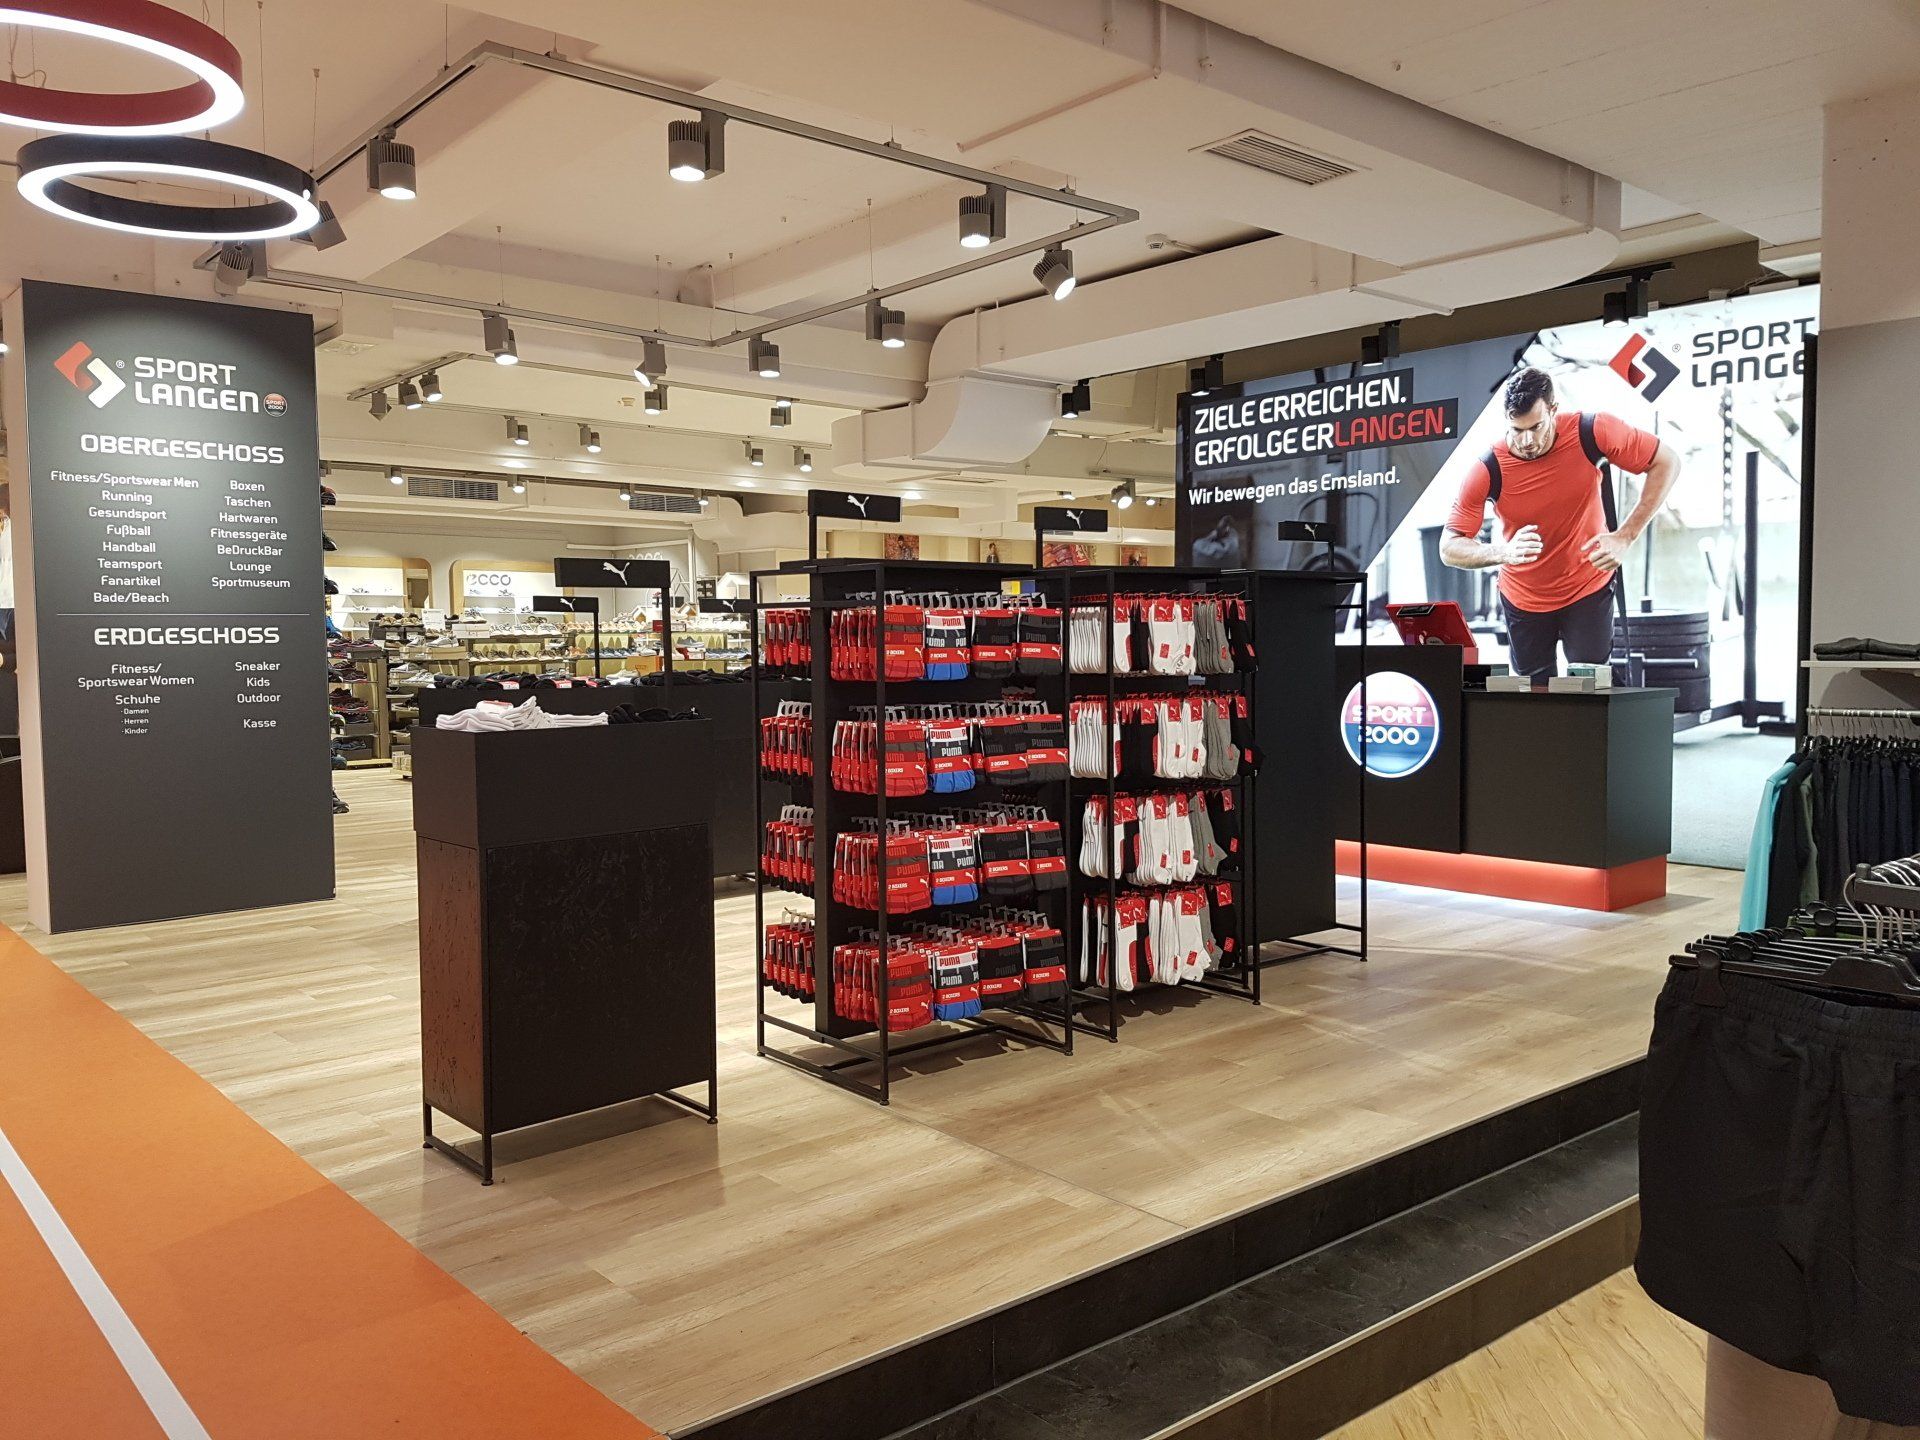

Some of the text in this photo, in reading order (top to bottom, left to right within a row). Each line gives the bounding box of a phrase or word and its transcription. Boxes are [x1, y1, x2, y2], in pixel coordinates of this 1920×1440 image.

[1692, 317, 1815, 358] SPORT
[134, 356, 237, 385] SPORT
[134, 381, 259, 413] LANGEN
[266, 399, 285, 407] SPORT
[1194, 376, 1407, 435] ZIELE ERREICHEN.
[1194, 406, 1451, 466] ERFOLGE ERLANGEN.
[80, 434, 285, 464] OBERGESCHOSS
[51, 470, 200, 489] Fitness/Sportswear Men
[230, 480, 265, 492] Boxen
[1189, 466, 1401, 506] Wir bewegen das Emsland.
[102, 491, 153, 505] Running
[224, 496, 272, 508] Taschen
[88, 507, 168, 522] Gesundsport
[219, 512, 278, 524] Hartwaren
[106, 525, 151, 538] Fußball
[210, 528, 288, 542] Fitnessgeräte
[102, 541, 156, 553] Handball
[217, 544, 283, 556] BeDruckBar
[97, 558, 163, 571] Teamsport
[229, 561, 272, 574] Lounge
[101, 575, 161, 587] Fanartikel
[211, 577, 291, 590] Sportmuseum
[466, 573, 511, 586] ecco
[93, 592, 170, 604] Bade/Beach
[943, 617, 962, 627] PUMA
[94, 627, 280, 646] ERDGESCHOSS
[927, 637, 945, 648] UMA
[111, 663, 162, 674] Fitness/
[234, 661, 281, 672] Sneaker
[78, 675, 195, 690] Sportswear Women
[246, 677, 271, 687] Kids
[115, 694, 161, 705] Schuhe
[236, 693, 281, 704] Outdoor
[1351, 705, 1427, 724] SPORT
[243, 719, 277, 729] Kasse
[931, 730, 951, 740] PUMA
[1358, 726, 1420, 746] 2000
[941, 746, 962, 757] PUMA
[886, 846, 908, 857] UMA
[896, 863, 921, 876] PUMA
[939, 955, 961, 967] PUMA
[890, 965, 912, 978] PUMA
[941, 974, 962, 987] PUMA
